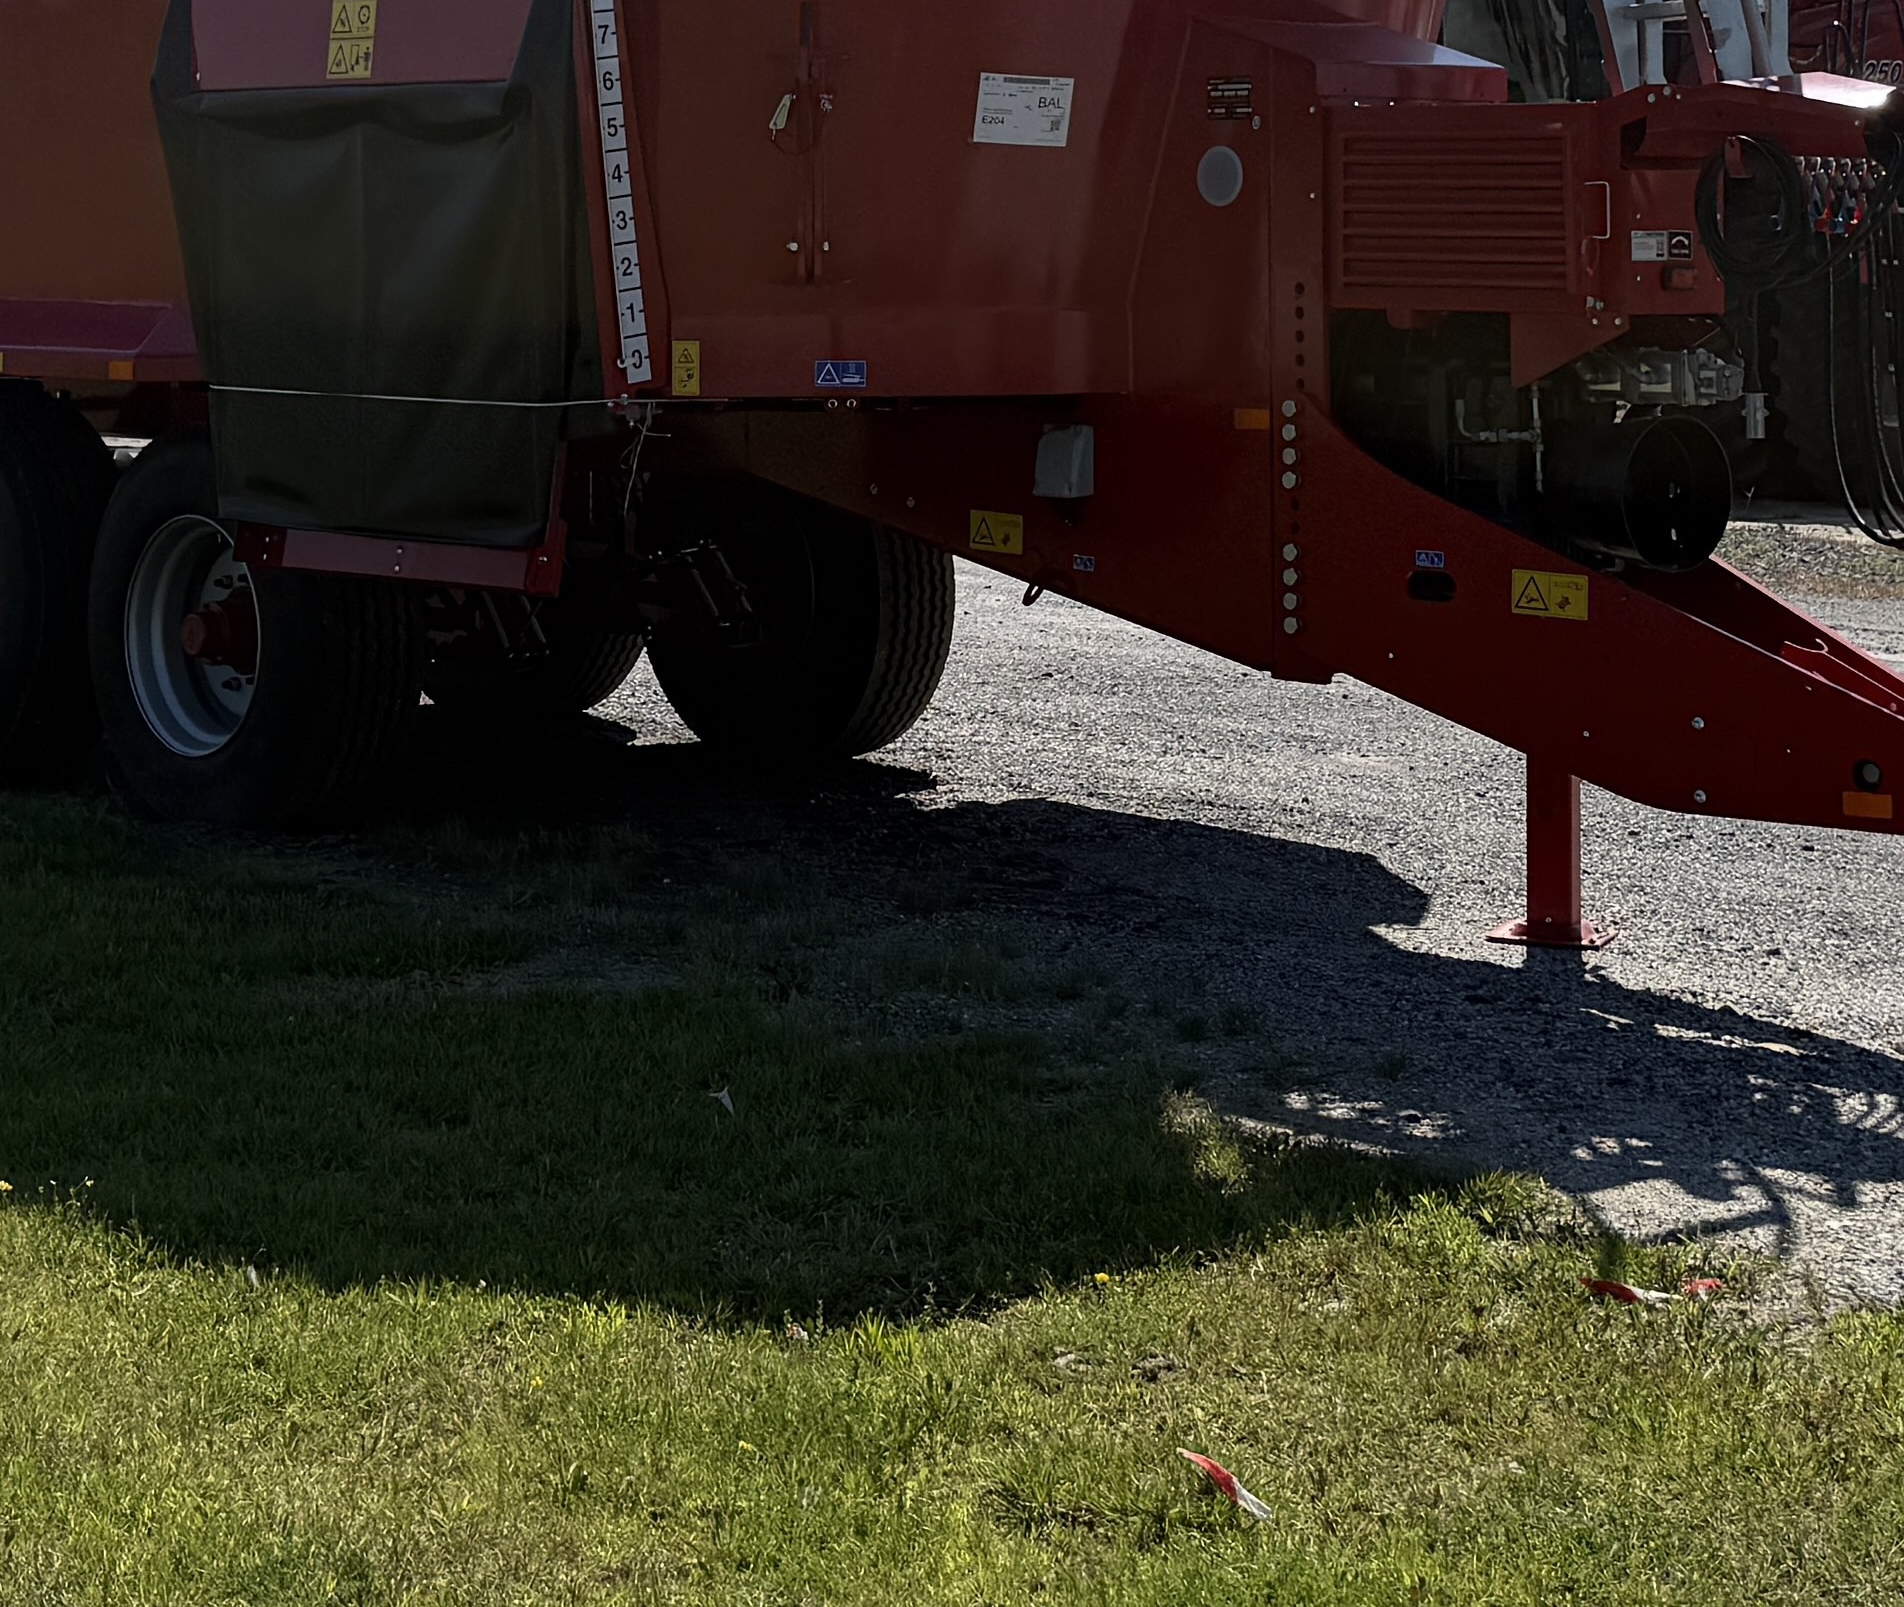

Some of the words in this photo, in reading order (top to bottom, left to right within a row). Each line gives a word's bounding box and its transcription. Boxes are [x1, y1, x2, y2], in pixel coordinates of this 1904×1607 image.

[598, 24, 610, 44] 7
[602, 71, 614, 91] 6
[607, 117, 618, 137] 5
[611, 163, 624, 183] 4
[616, 210, 628, 230] 3
[620, 257, 633, 276] 2
[626, 302, 636, 323] 1
